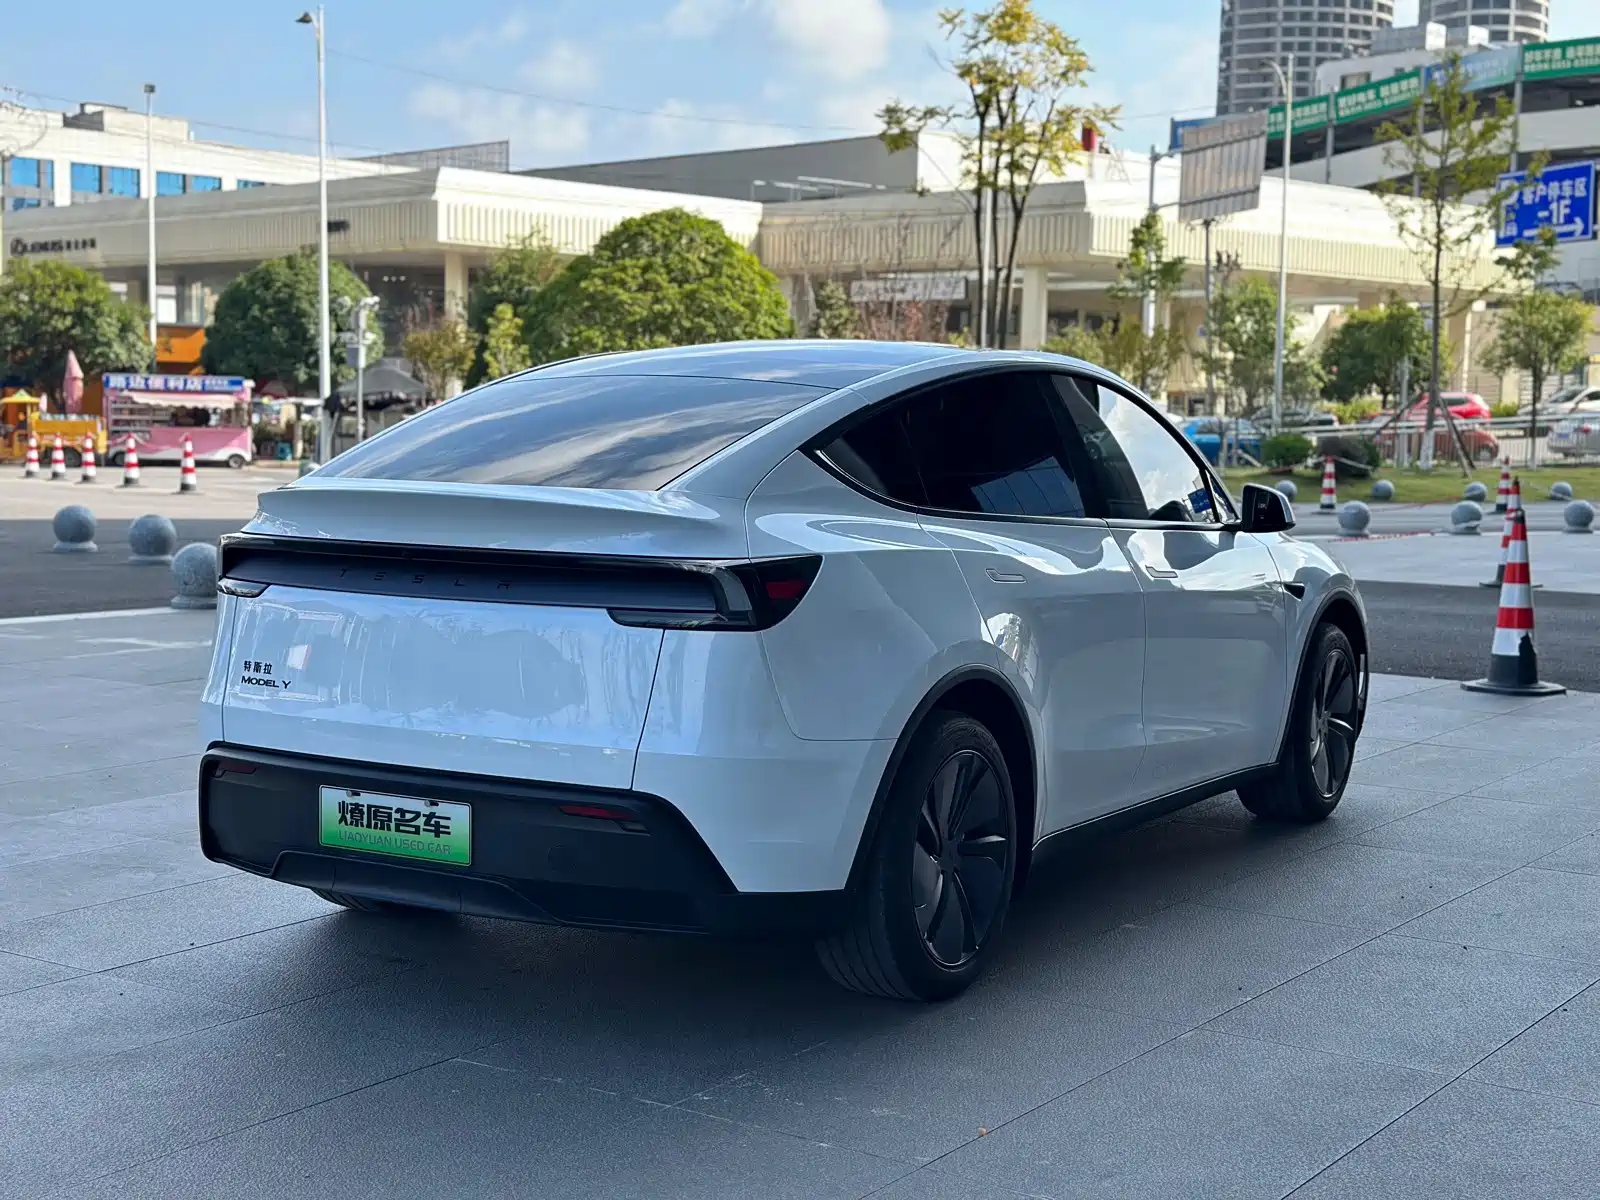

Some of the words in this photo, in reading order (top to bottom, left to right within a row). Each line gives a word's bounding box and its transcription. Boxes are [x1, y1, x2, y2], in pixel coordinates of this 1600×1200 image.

[1522, 177, 1587, 205] 客户停车区
[1537, 198, 1571, 225] -1F
[339, 568, 511, 590] TESLA
[243, 660, 273, 675] 特斯拉
[241, 675, 280, 688] MODEL
[281, 680, 292, 690] Y
[338, 800, 452, 838] 燎原名车
[338, 829, 393, 847] LIAOYUAN
[394, 837, 425, 851] USED
[427, 842, 451, 855] CAR
